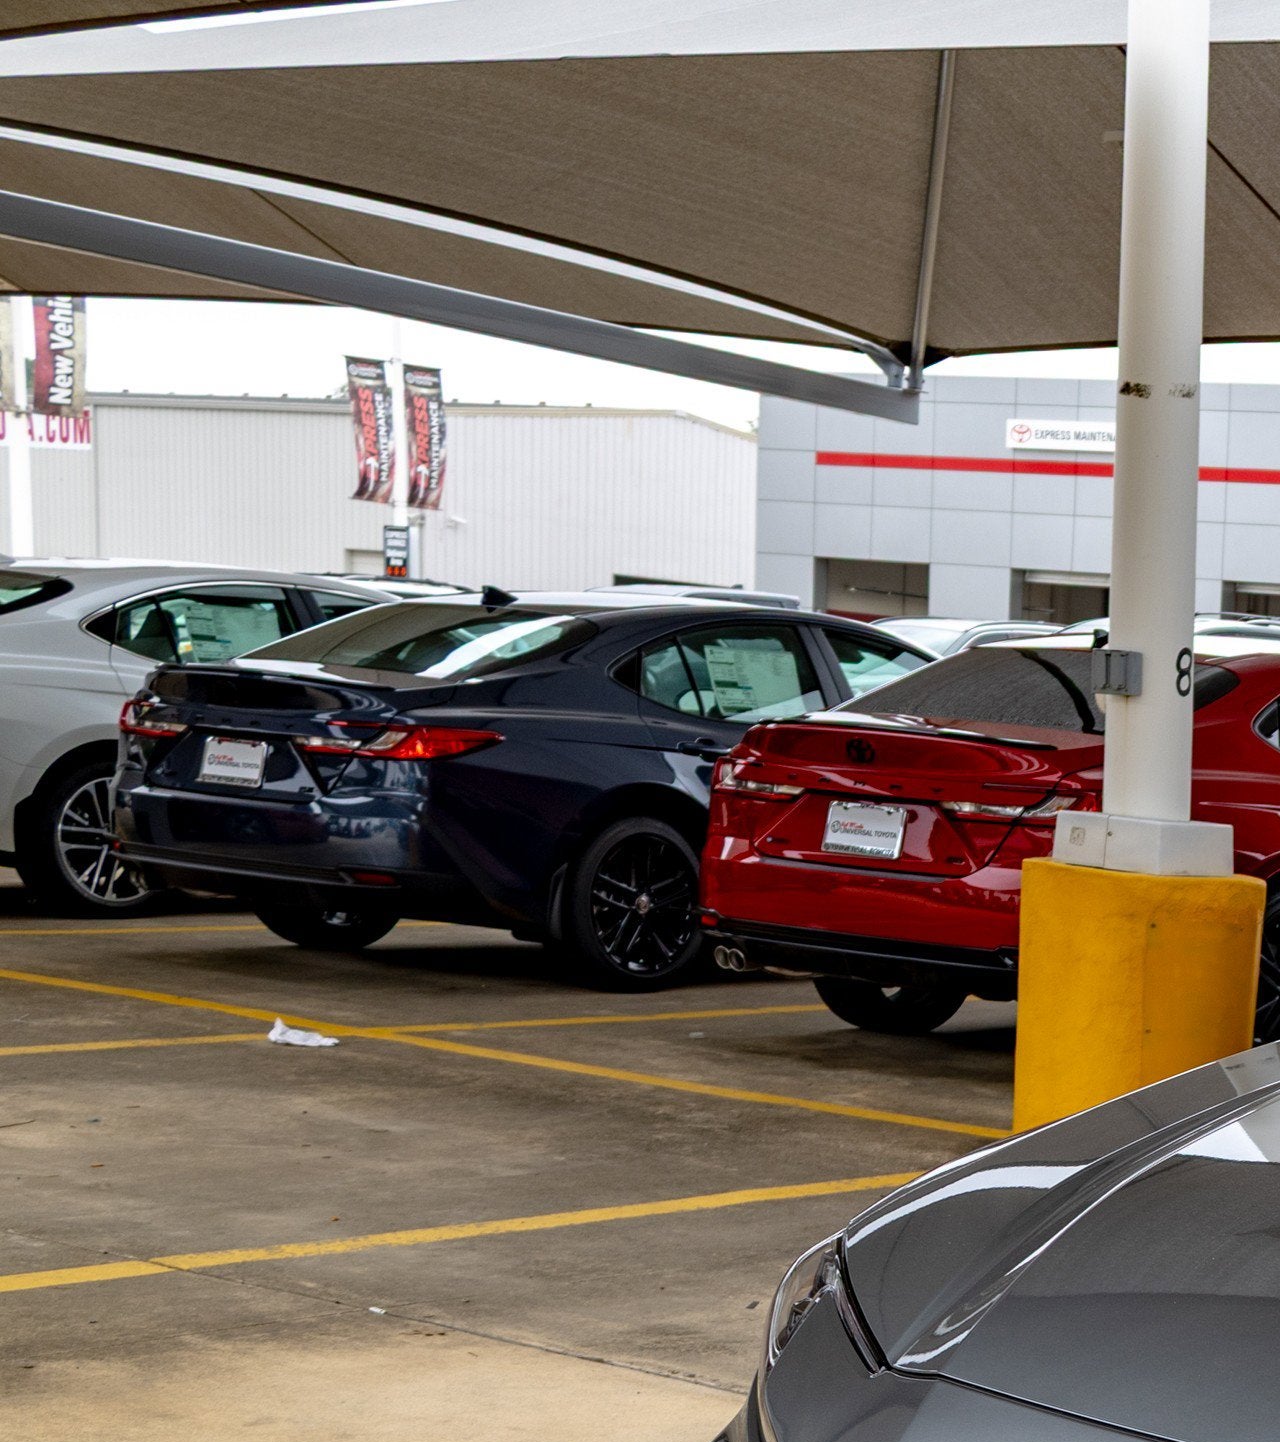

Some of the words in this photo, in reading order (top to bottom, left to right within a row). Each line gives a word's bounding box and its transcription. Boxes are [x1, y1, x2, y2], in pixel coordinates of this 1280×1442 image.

[49, 355, 74, 405] New
[374, 392, 389, 482] MAINTENANCE
[428, 401, 440, 489] MAINTENANCE
[1034, 429, 1071, 441] EXPRESS
[1175, 647, 1193, 697] 8
[840, 828, 873, 837] UNIVERSAL
[874, 830, 897, 840] TOYOTA
